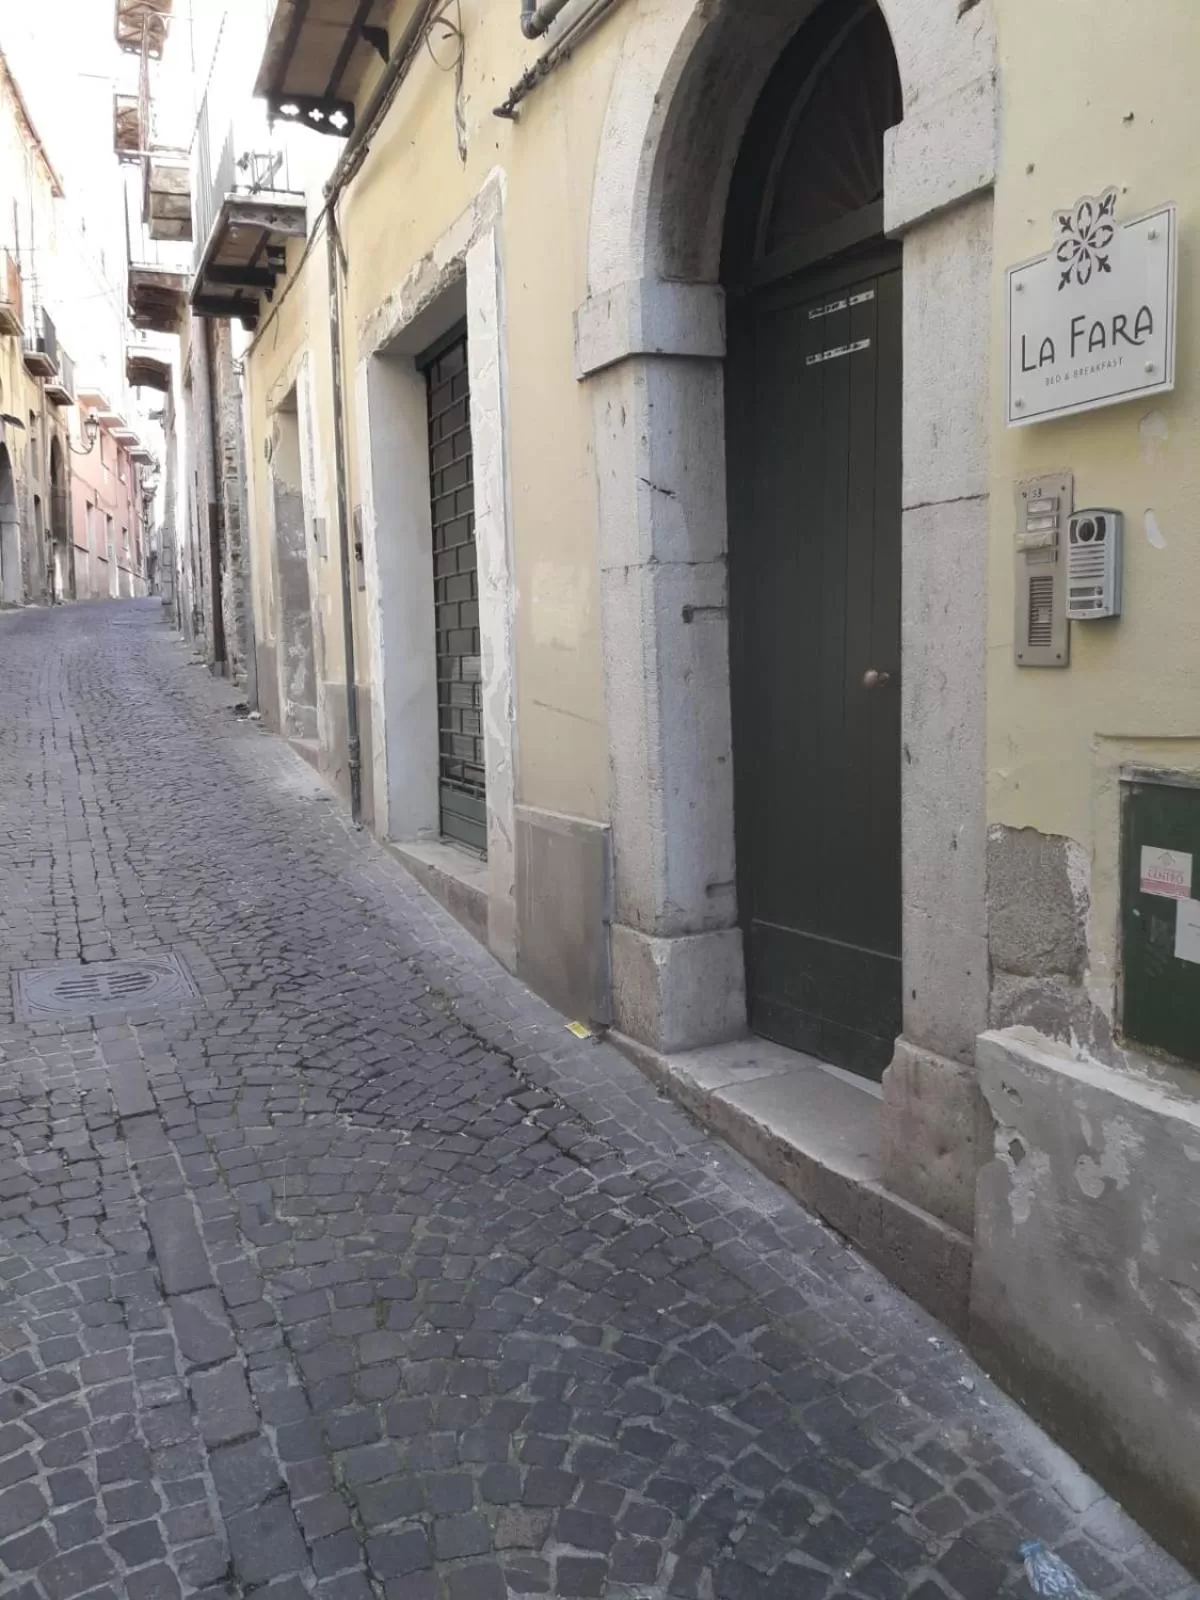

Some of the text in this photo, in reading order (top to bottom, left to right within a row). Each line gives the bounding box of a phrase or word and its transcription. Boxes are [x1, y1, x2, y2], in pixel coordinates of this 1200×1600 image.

[1022, 305, 1153, 372] LA FARA
[1045, 356, 1123, 386] BED & BREAKFAST
